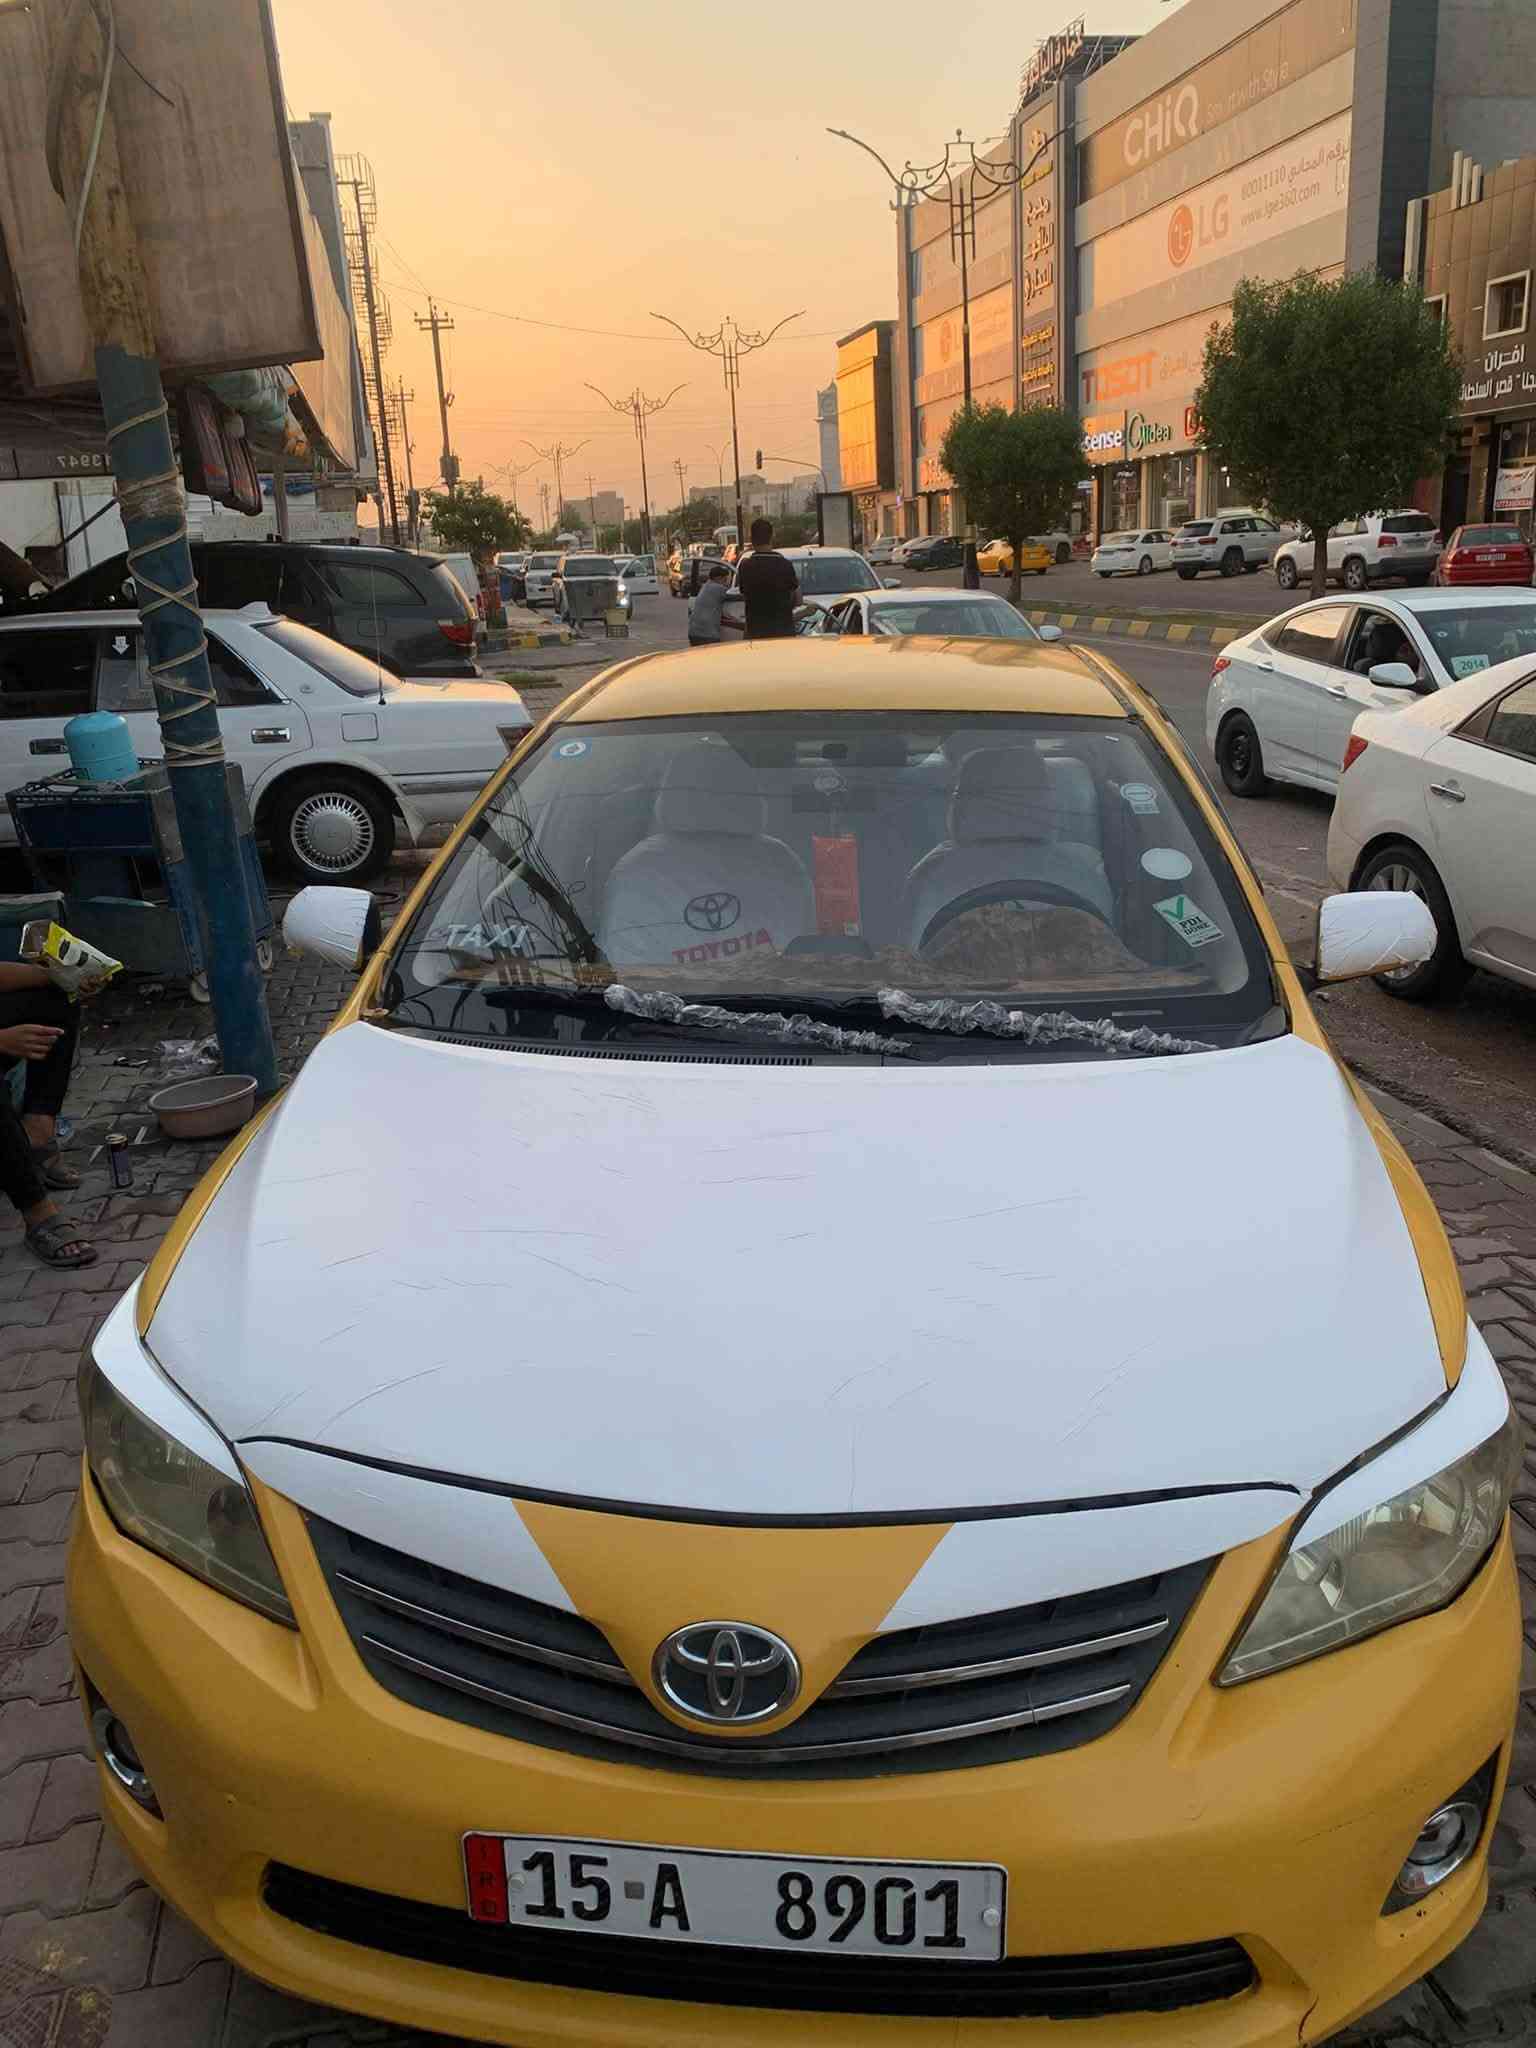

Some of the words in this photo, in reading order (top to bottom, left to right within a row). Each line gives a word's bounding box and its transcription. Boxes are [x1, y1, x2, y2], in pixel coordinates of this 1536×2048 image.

[1123, 84, 1199, 167] CHiQ
[1199, 193, 1229, 246] LG
[1484, 343, 1525, 373] افران
[1494, 375, 1513, 399] قصر
[1083, 429, 1124, 452] sense
[1129, 412, 1172, 452] Midea
[1460, 659, 1486, 672] 2014
[447, 924, 529, 949] TAXI
[1179, 916, 1204, 928] PDI
[671, 927, 770, 964] TOYOTA
[522, 1851, 611, 1922] 15
[649, 1863, 691, 1931] A
[774, 1871, 966, 1949] 8901
